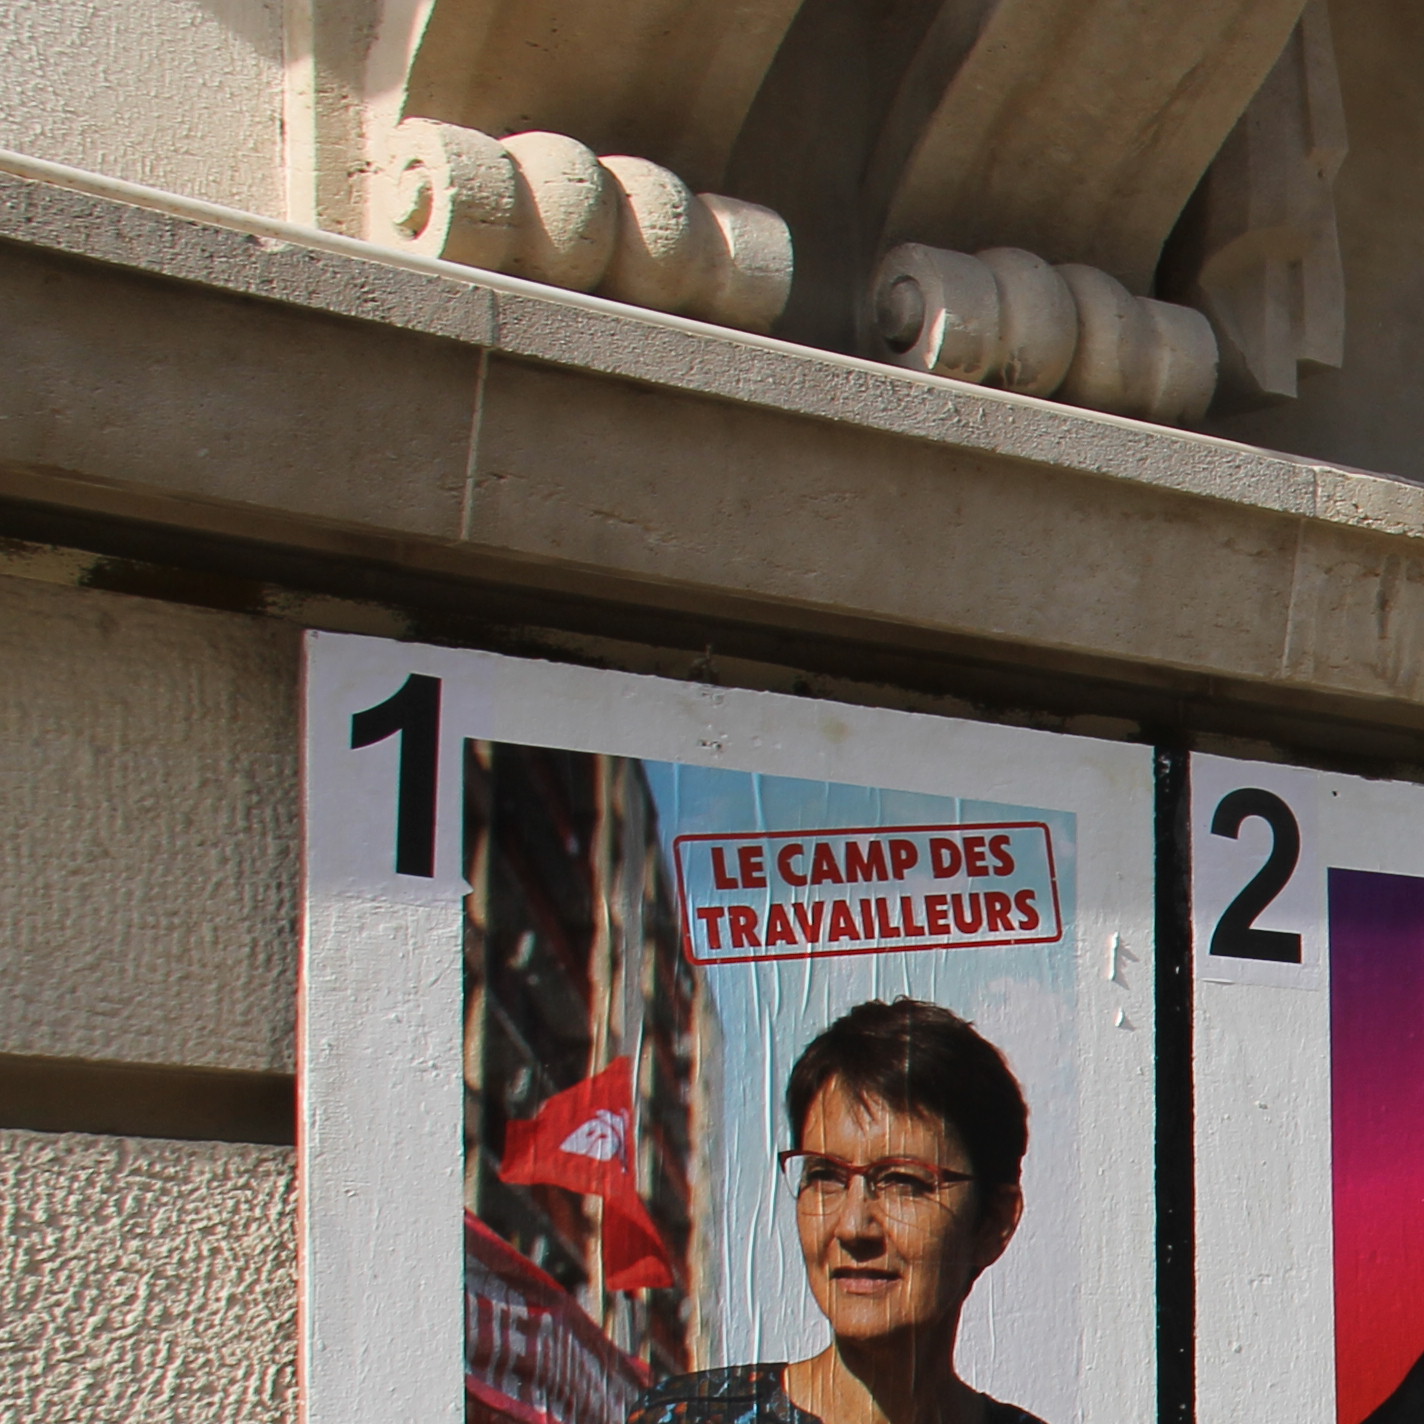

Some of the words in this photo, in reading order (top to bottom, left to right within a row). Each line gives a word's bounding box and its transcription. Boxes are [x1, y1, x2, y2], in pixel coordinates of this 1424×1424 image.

[350, 673, 442, 878] 1
[696, 889, 1040, 950] TRAVAILLEURS
[710, 846, 765, 891] LE
[776, 839, 919, 888] CAMP
[931, 834, 1015, 879] DES
[1209, 787, 1302, 964] 2
